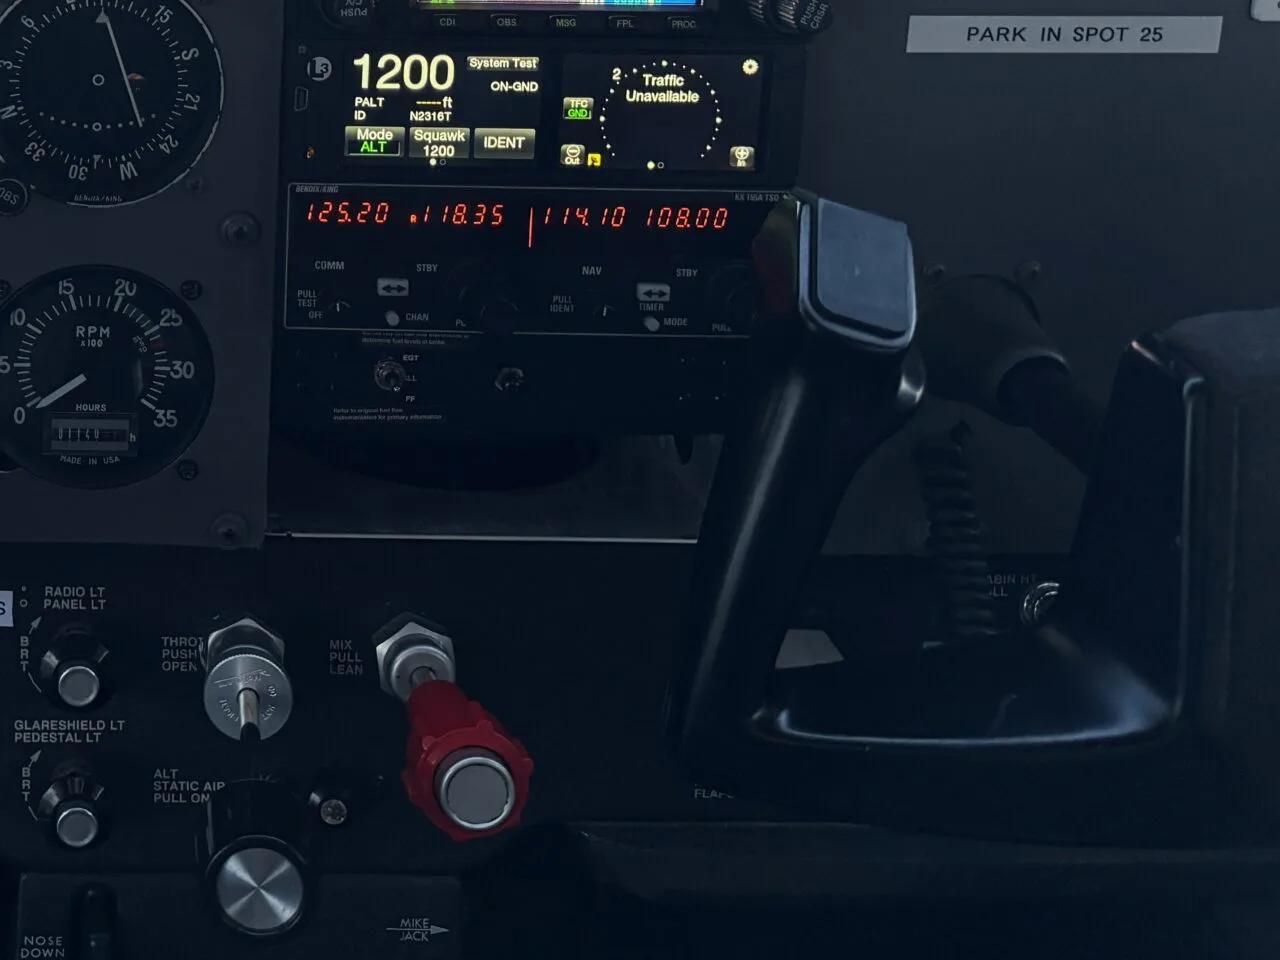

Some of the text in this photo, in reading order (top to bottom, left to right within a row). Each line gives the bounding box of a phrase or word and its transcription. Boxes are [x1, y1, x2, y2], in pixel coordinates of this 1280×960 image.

[440, 18, 456, 27] CDI
[497, 18, 517, 27] OBS
[556, 18, 576, 27] MSG
[617, 19, 634, 28] FPL
[672, 20, 696, 29] PROC
[967, 26, 1164, 42] PARK IN SPOT 25
[469, 58, 537, 71] System Test
[354, 53, 455, 91] 1200
[643, 74, 685, 87] Traffic
[490, 81, 539, 93] ON-GND
[355, 97, 385, 108] PALT
[626, 90, 699, 103] Unavailable
[355, 110, 451, 121] ID N2316T
[357, 129, 394, 141] Mode
[414, 129, 466, 145] Squawk
[361, 142, 387, 153] ALT
[484, 136, 525, 149] IDENT
[424, 145, 455, 157] 1200
[308, 202, 390, 223] 125.20
[423, 204, 505, 225] 118.35
[544, 206, 626, 228] 114.10
[647, 208, 729, 229] 108.00
[315, 261, 345, 271] COMM
[416, 263, 438, 273] STBY
[583, 266, 602, 276] NAV
[676, 269, 698, 278] STBY
[160, 309, 183, 327] 25
[76, 326, 111, 338] RPM
[171, 361, 196, 379] 30
[154, 410, 177, 428] 35
[45, 586, 105, 598] RADIO LT
[44, 599, 106, 611] PANEL LT
[330, 640, 353, 650] MIX
[330, 652, 363, 662] PULL
[330, 665, 364, 675] LEAN
[14, 720, 125, 732] GLARESHIELD LT
[14, 732, 102, 743] PEDESTAL LT
[400, 918, 430, 929] MIKE
[24, 936, 62, 946] NOSE
[400, 931, 429, 942] JACK
[21, 948, 65, 958] DOWN
